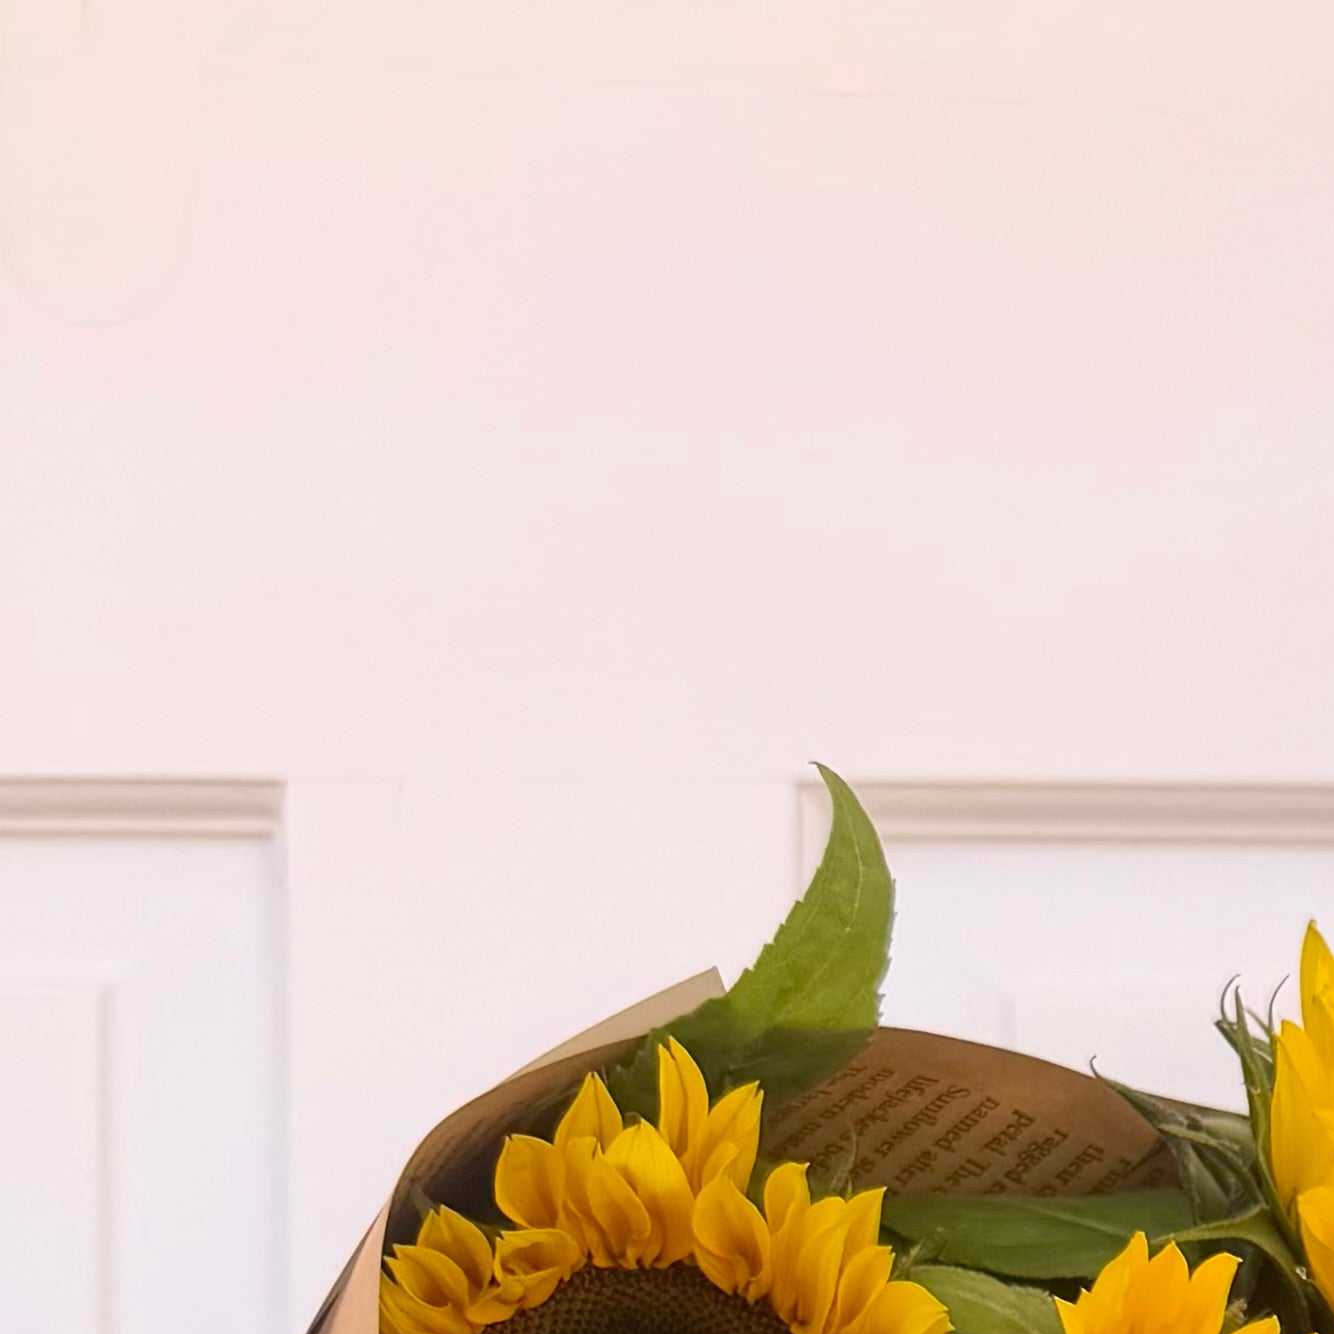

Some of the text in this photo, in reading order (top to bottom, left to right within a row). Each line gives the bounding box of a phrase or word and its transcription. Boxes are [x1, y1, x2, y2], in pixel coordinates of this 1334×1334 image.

[872, 1085, 970, 1158] Sunflower
[893, 1096, 1000, 1186] named after
[945, 1158, 987, 1186] The
[1003, 1128, 1069, 1185] ragged
[1055, 1144, 1104, 1186] their
